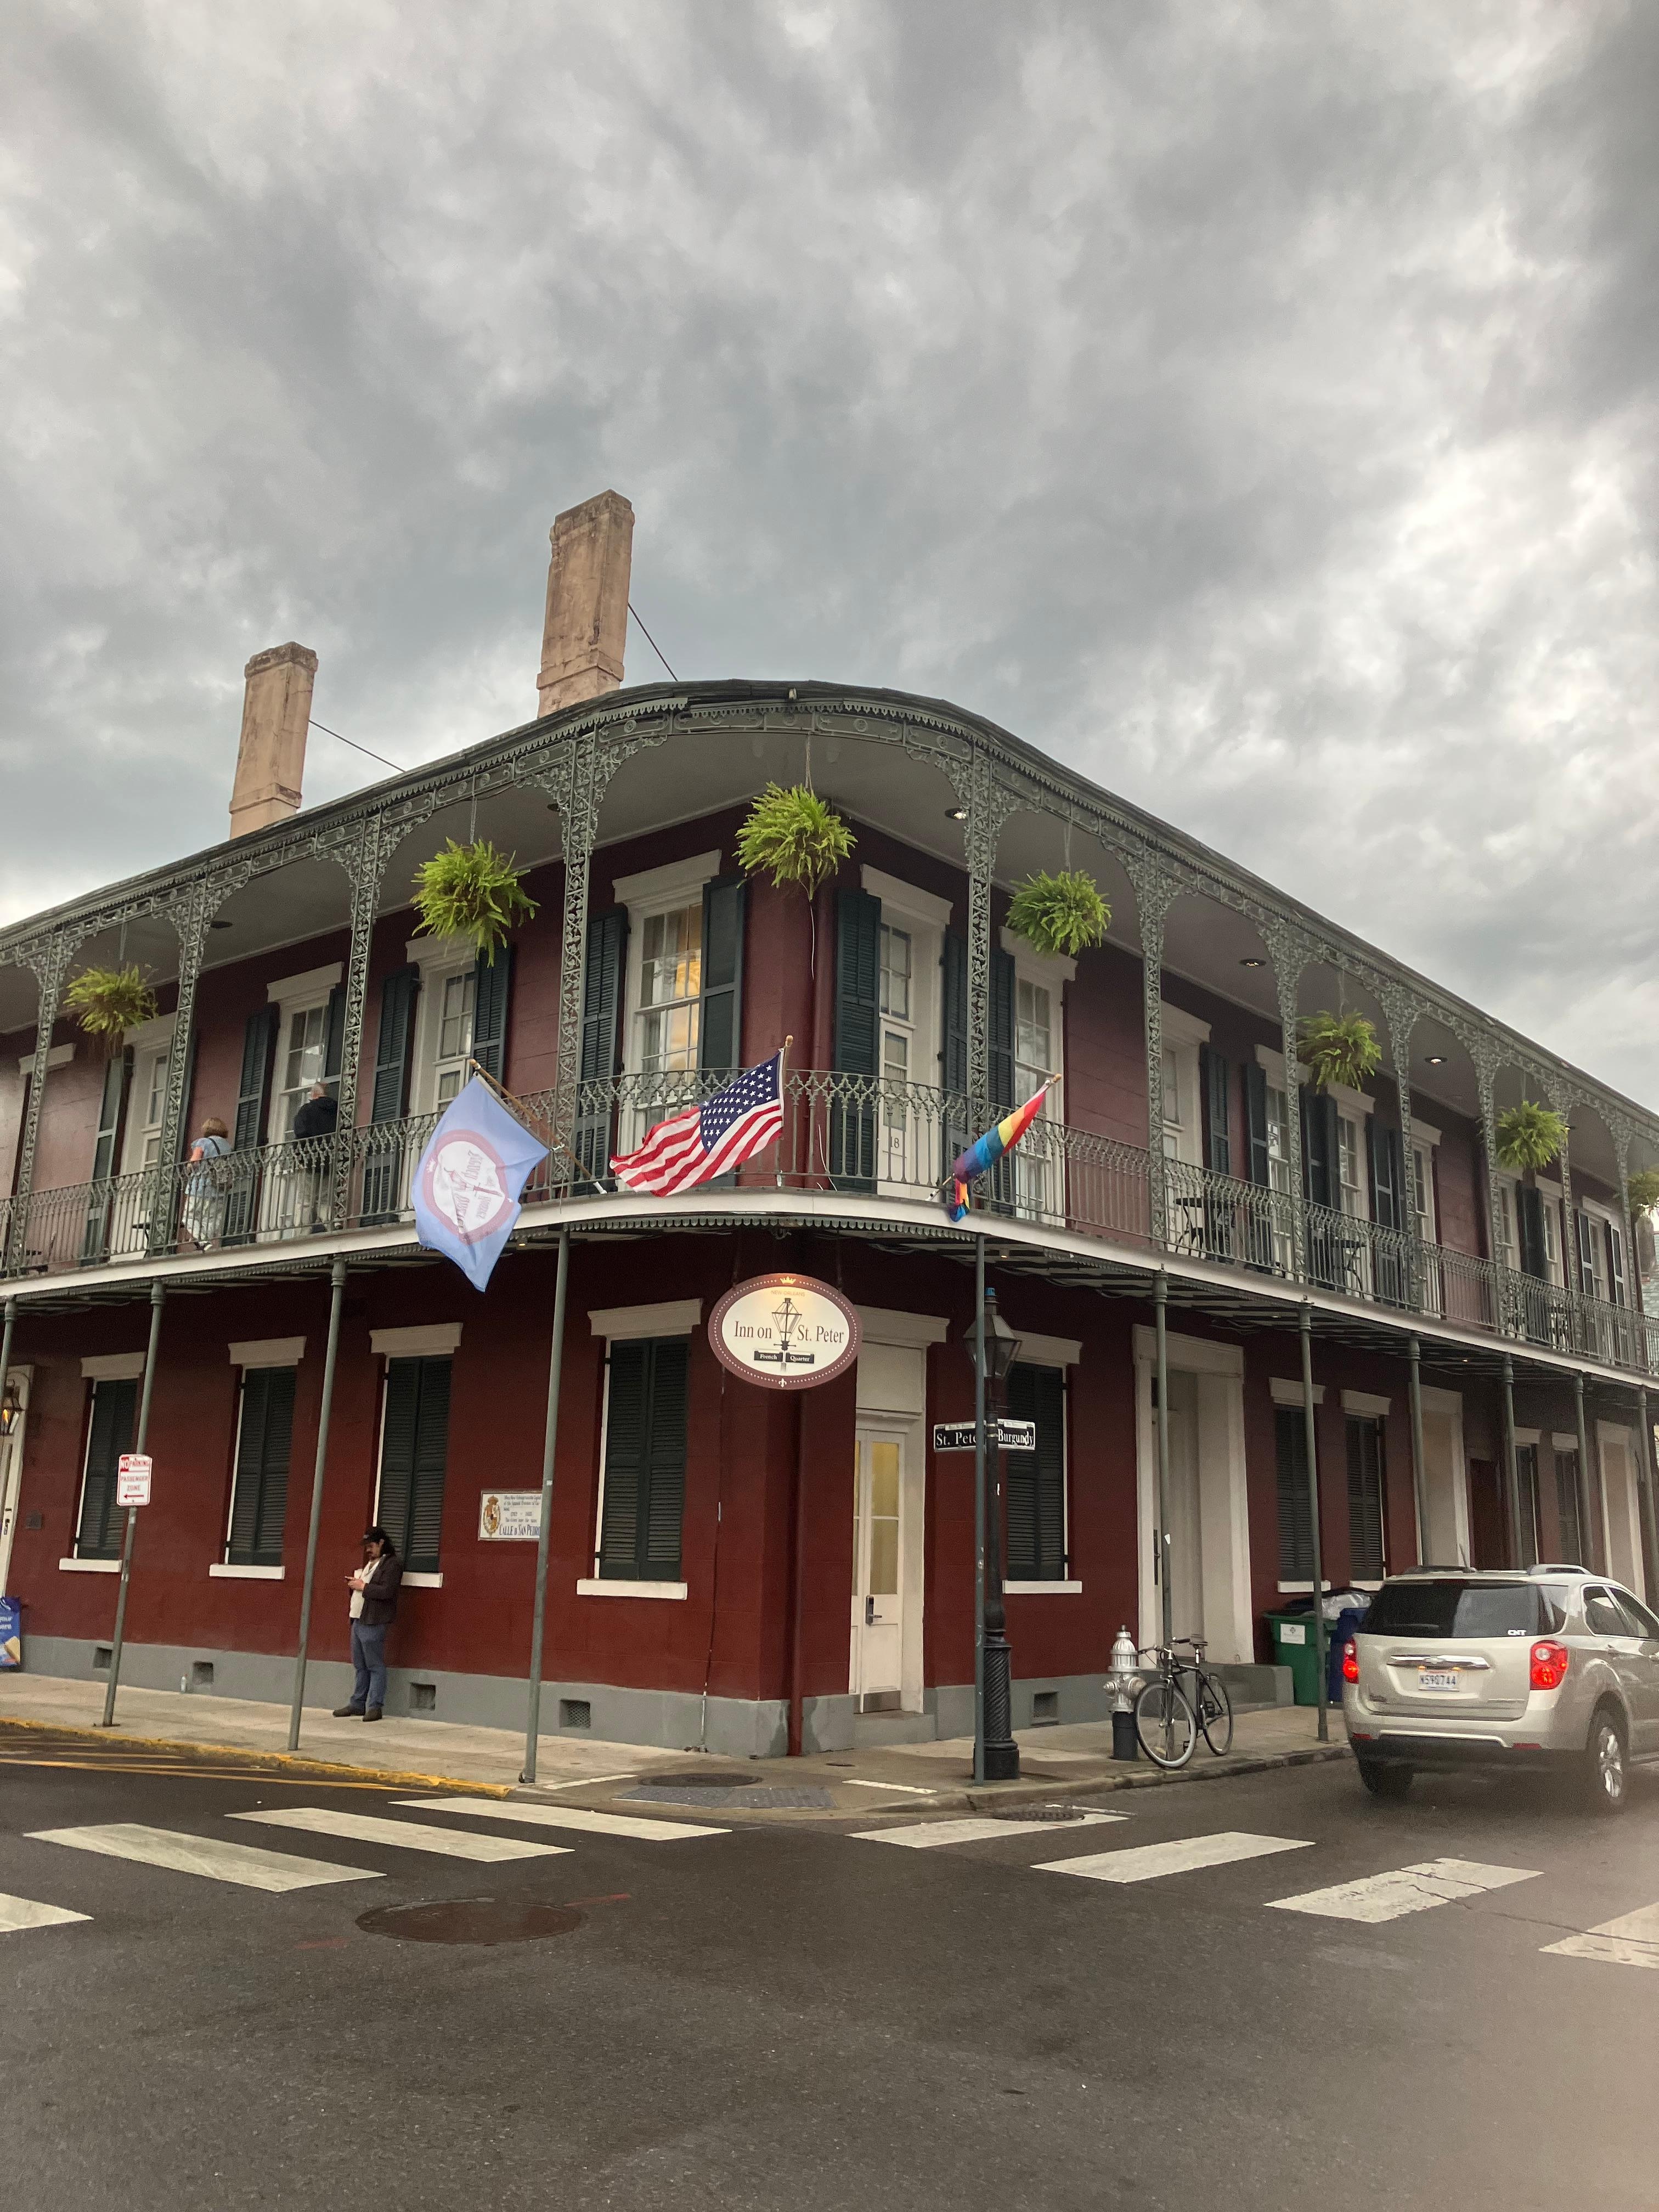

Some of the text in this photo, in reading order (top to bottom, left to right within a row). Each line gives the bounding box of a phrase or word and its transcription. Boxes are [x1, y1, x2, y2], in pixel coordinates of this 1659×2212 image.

[734, 1321, 844, 1343] Inn on St. Peter
[936, 1432, 977, 1446] St. Pet
[997, 1429, 1033, 1447] Burgundy
[120, 1459, 129, 1469] NO
